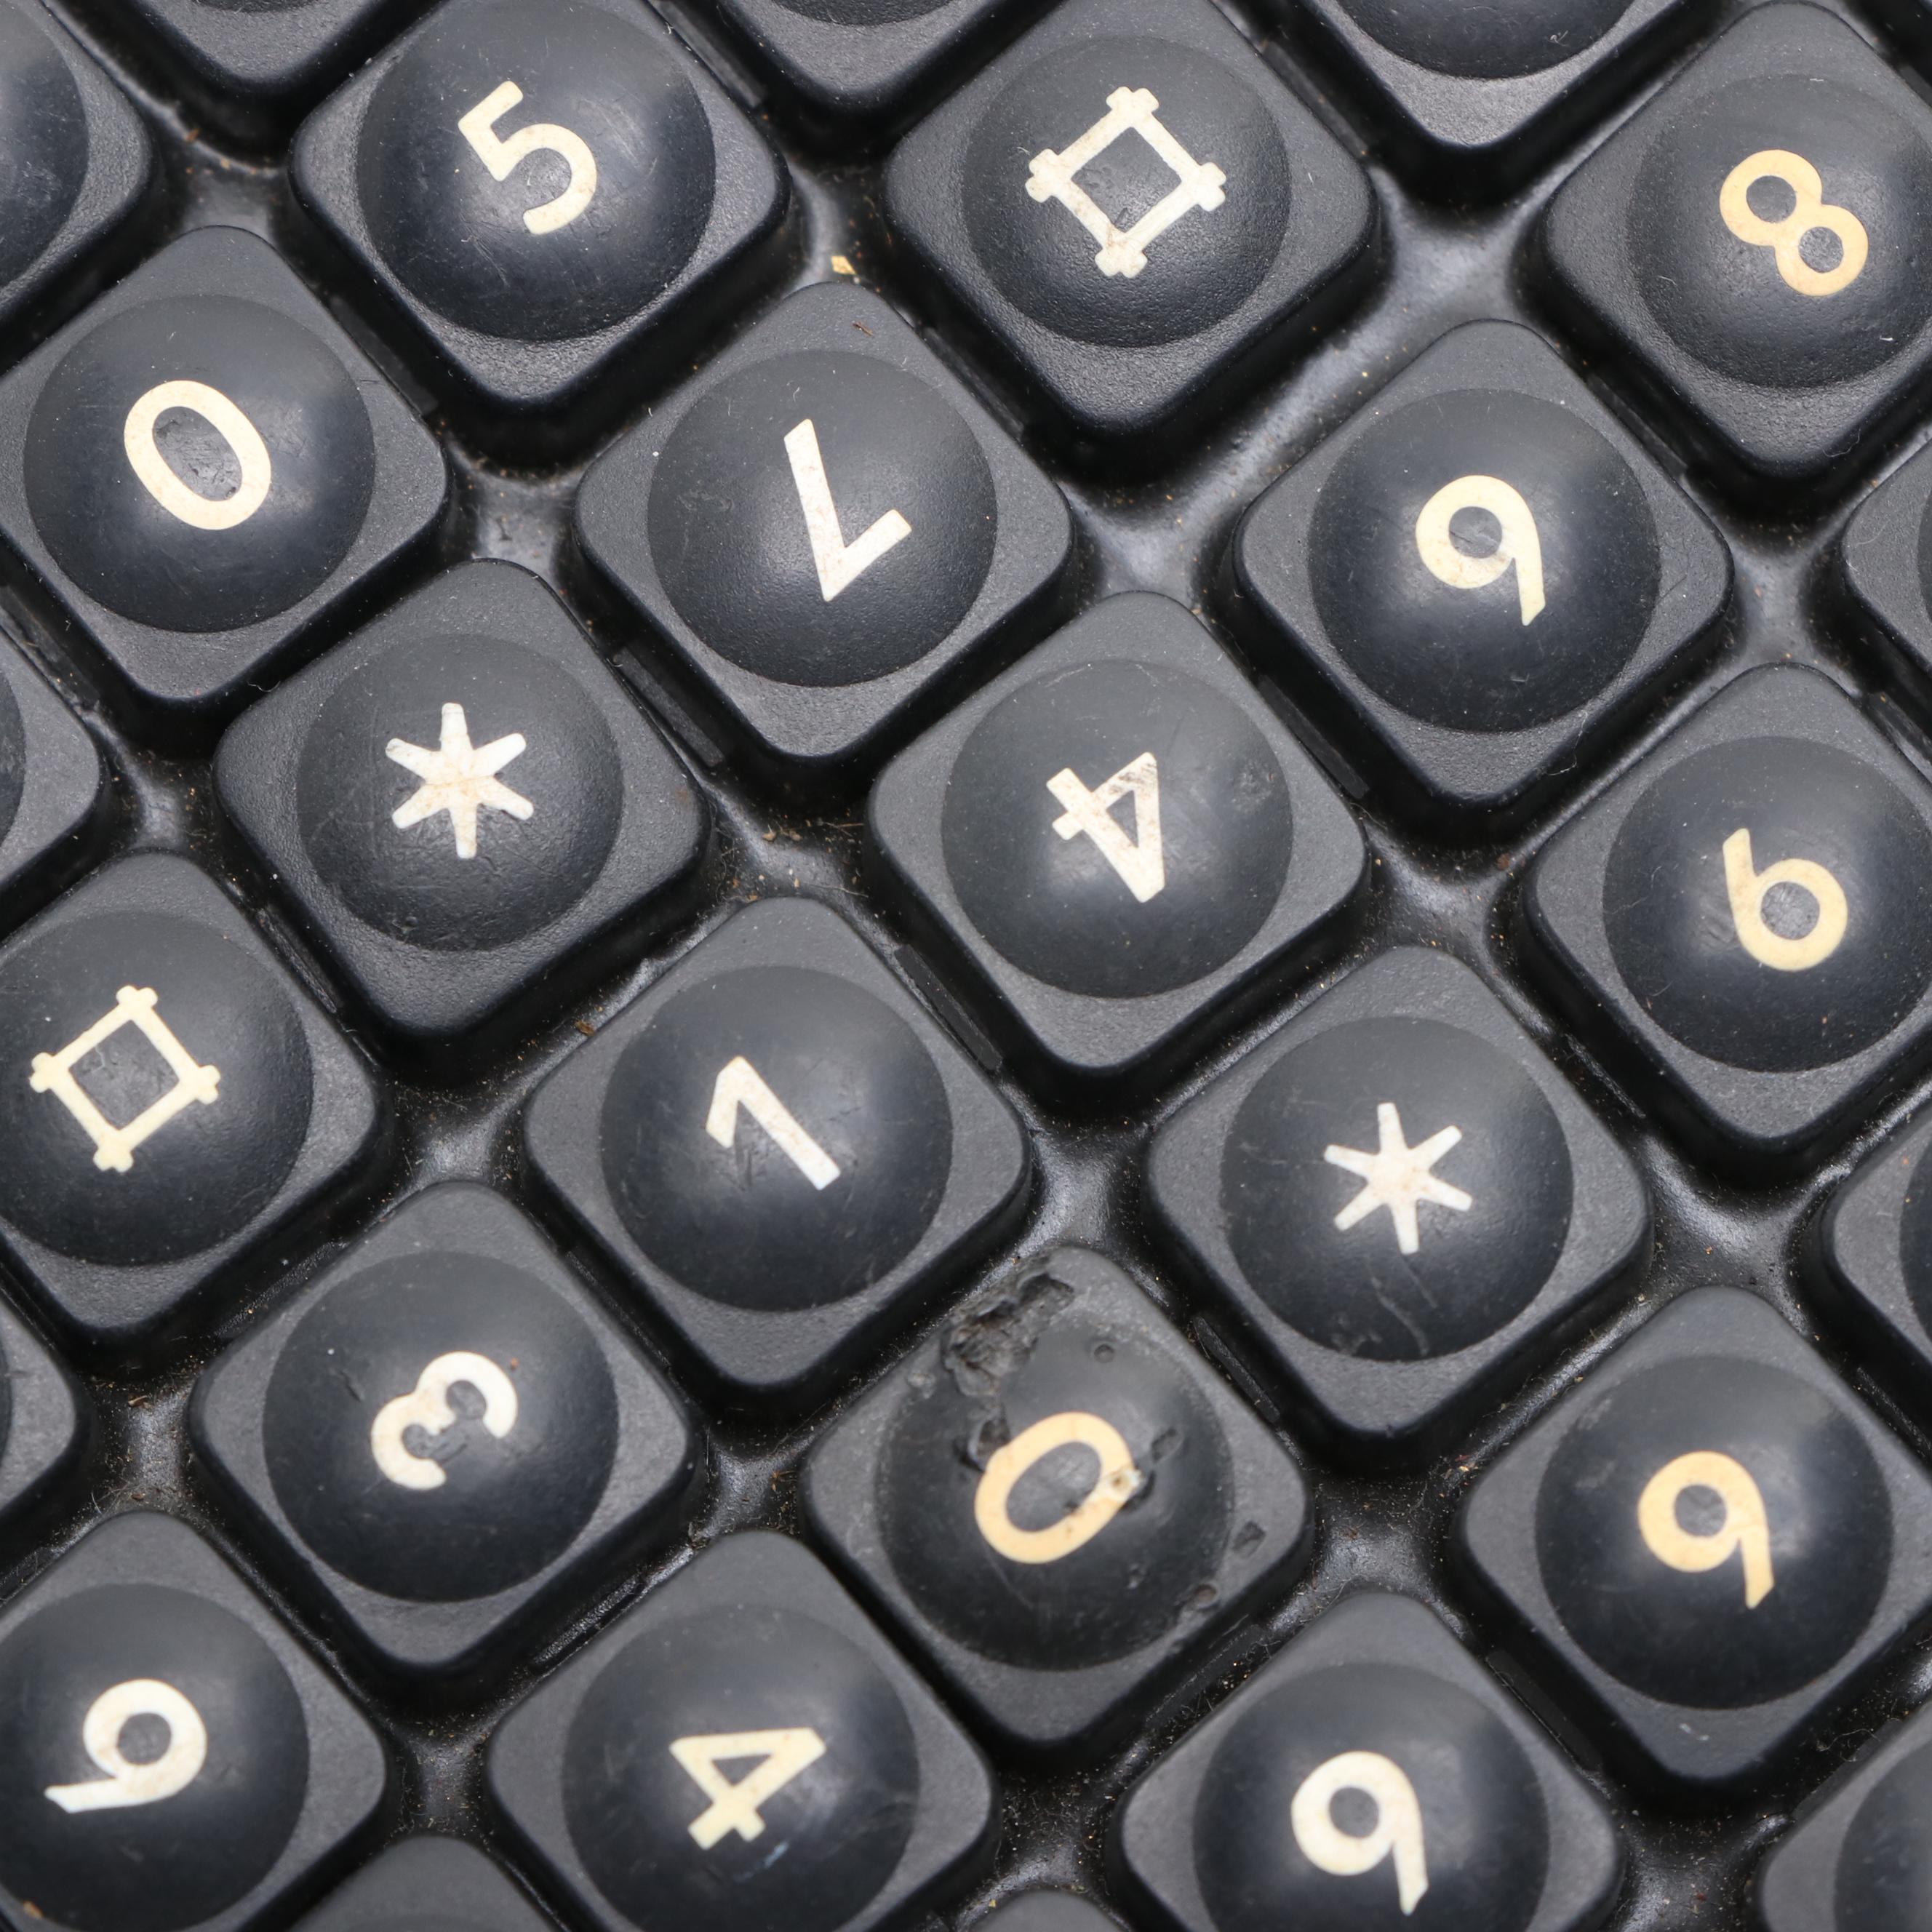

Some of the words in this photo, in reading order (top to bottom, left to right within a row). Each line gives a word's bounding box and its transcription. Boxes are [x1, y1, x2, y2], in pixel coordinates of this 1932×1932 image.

[458, 79, 598, 236] 5
[1719, 149, 1869, 297] 8
[783, 418, 912, 602] 7
[1047, 753, 1166, 902] 4
[370, 1351, 519, 1490] 3
[672, 1730, 825, 1848] 4
